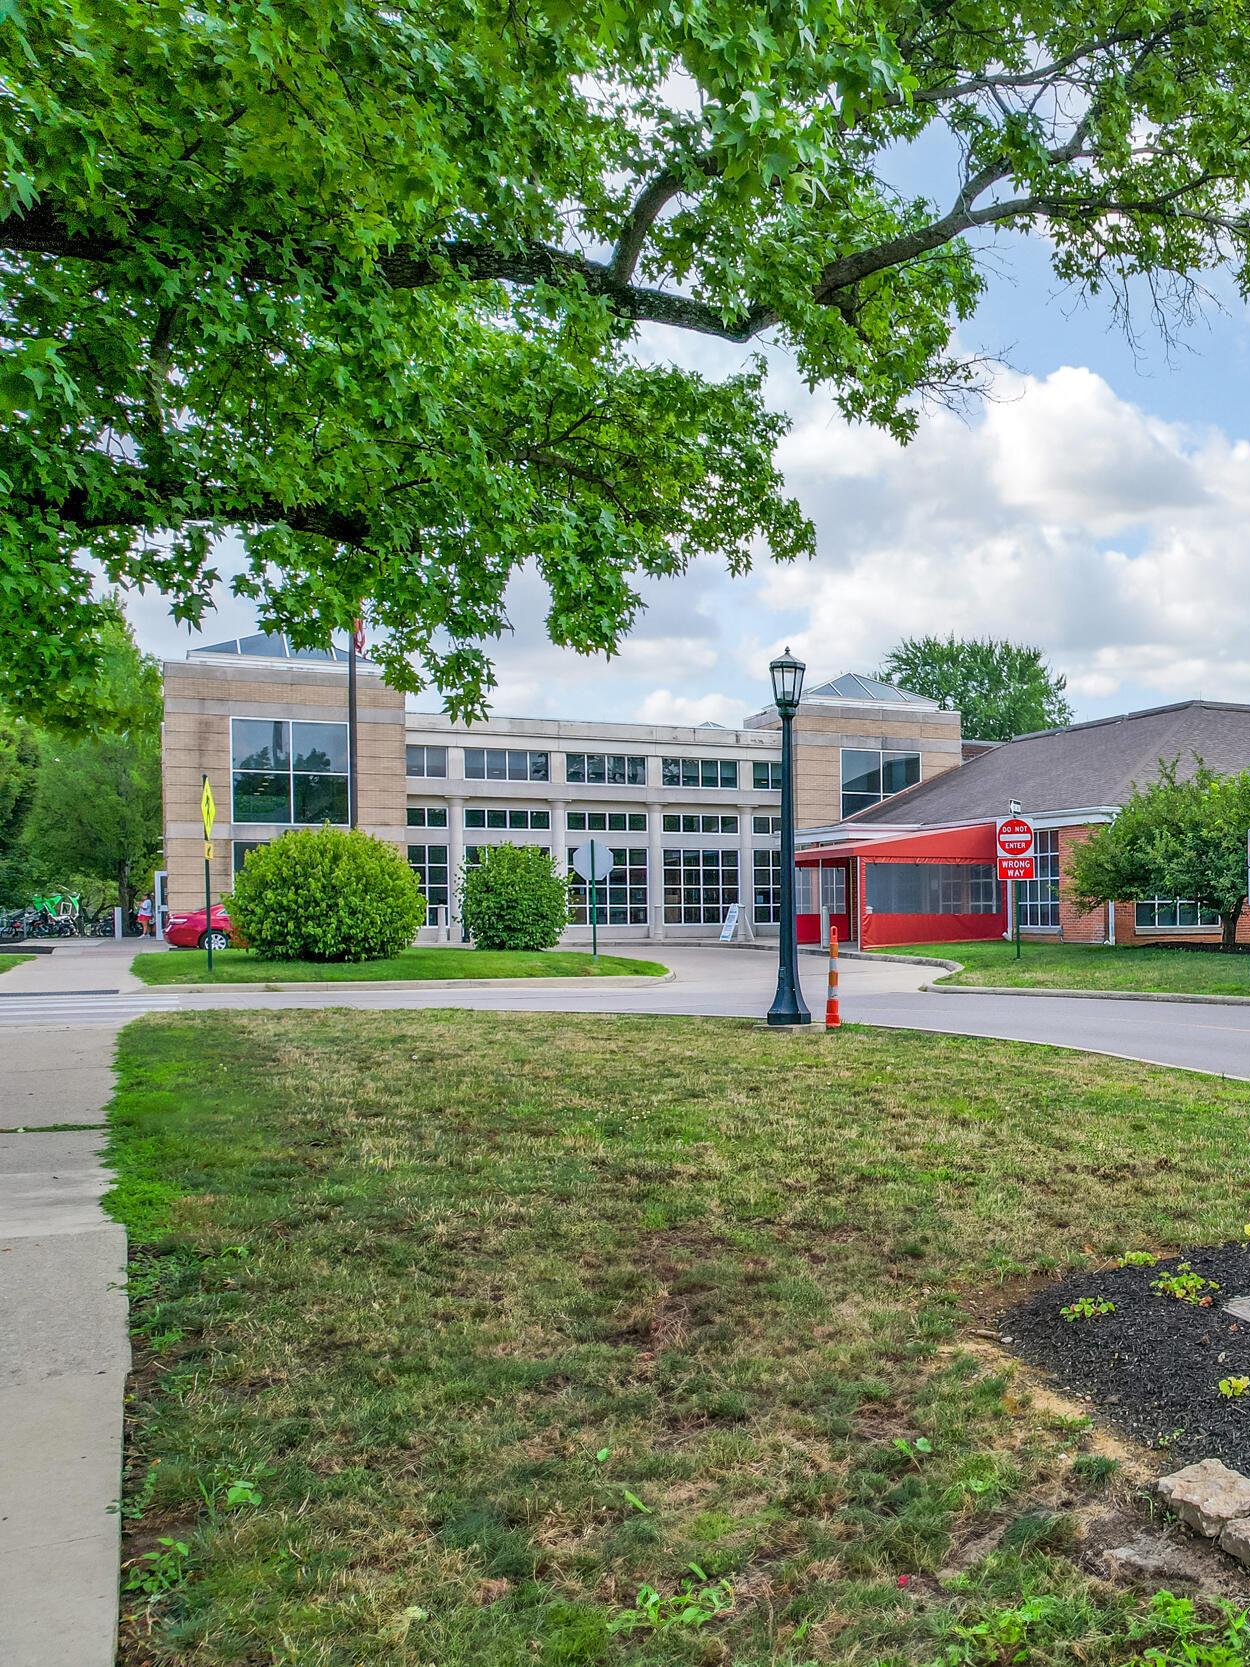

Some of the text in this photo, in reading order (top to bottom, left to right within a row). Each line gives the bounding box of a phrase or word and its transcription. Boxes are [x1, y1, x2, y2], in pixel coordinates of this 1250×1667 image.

[1014, 825, 1028, 833] NOT
[1002, 860, 1030, 868] WRONG
[1007, 869, 1025, 877] WAY
